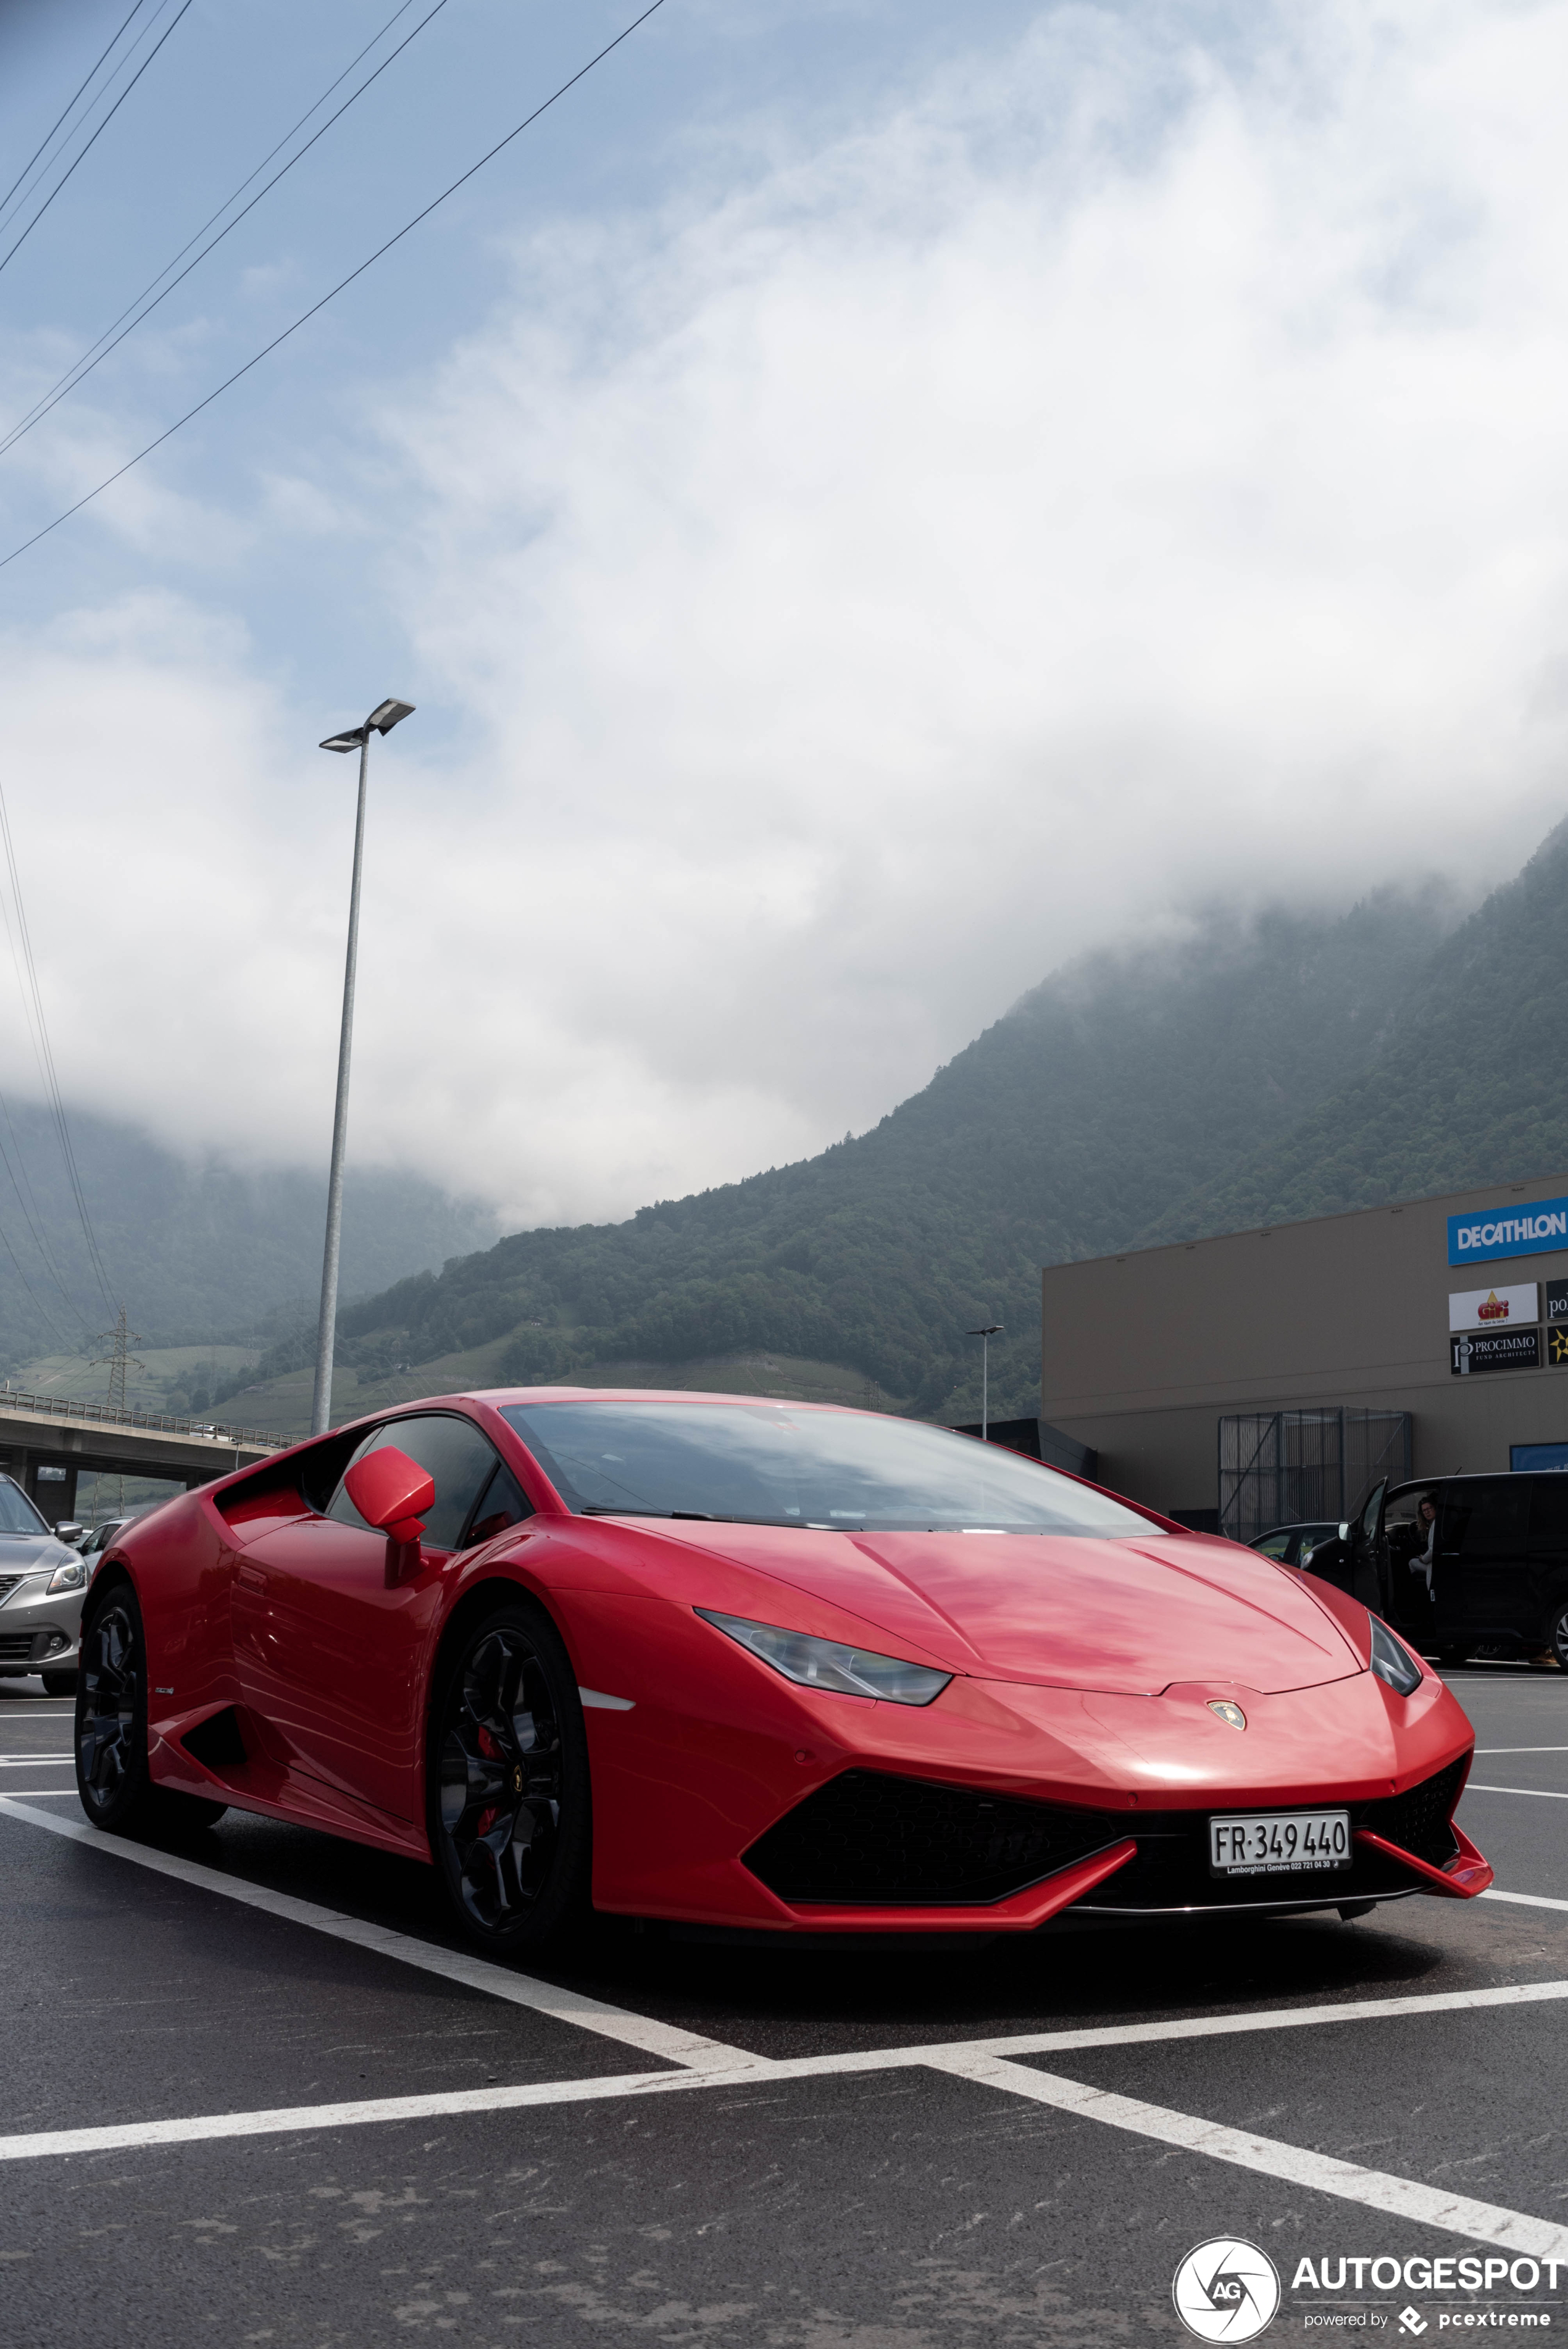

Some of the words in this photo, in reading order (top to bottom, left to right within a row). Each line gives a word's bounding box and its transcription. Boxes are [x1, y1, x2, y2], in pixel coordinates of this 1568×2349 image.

[1457, 1212, 1566, 1250] DECATHLON
[1549, 1293, 1568, 1318] po
[1475, 1336, 1535, 1353] PROCIMMO
[1495, 1350, 1535, 1359] ARCHITECTS
[1227, 1865, 1266, 1874] Lamborghini
[1267, 1863, 1290, 1871] Genève
